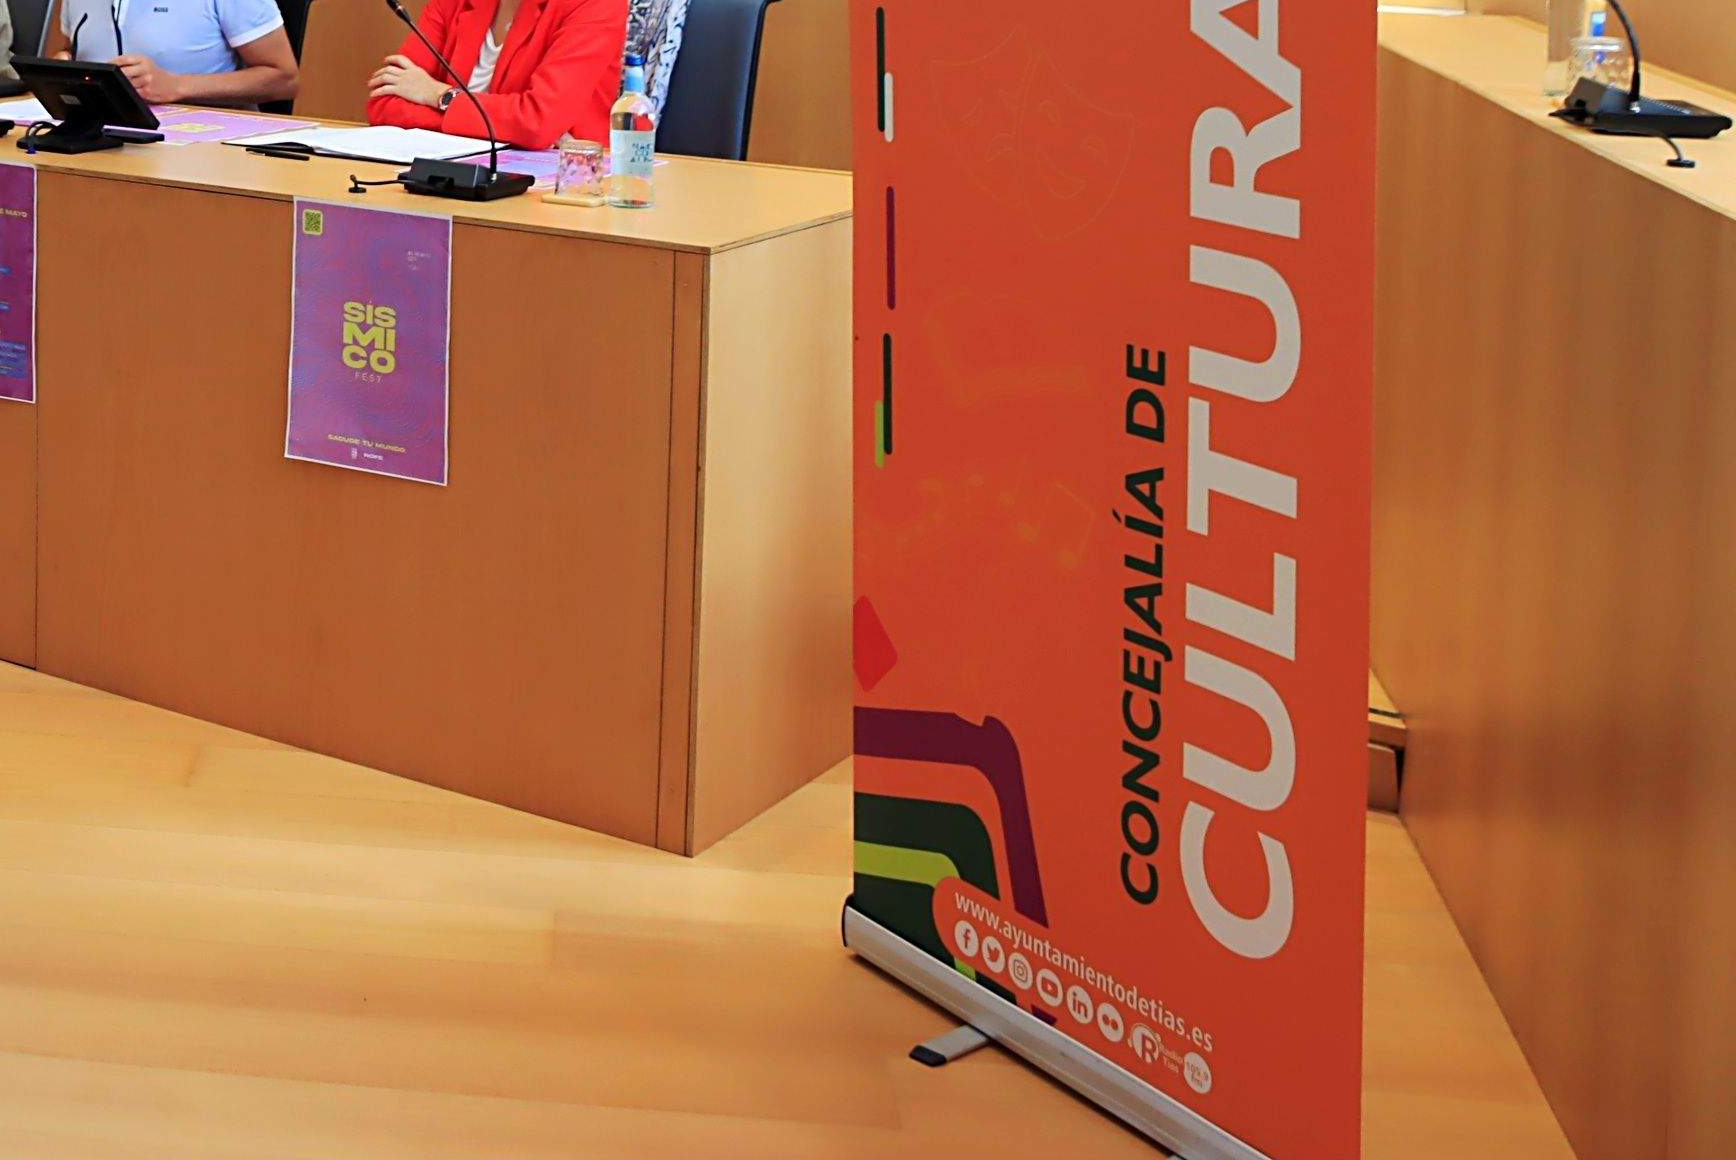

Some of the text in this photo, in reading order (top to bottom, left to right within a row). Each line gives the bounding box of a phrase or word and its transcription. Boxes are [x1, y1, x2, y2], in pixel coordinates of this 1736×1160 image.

[342, 321, 397, 353] MI
[342, 344, 396, 374] CO
[1113, 343, 1173, 906] CONCEJALÍA DE
[954, 890, 1214, 1054] www.ayuntamientodetias.es
